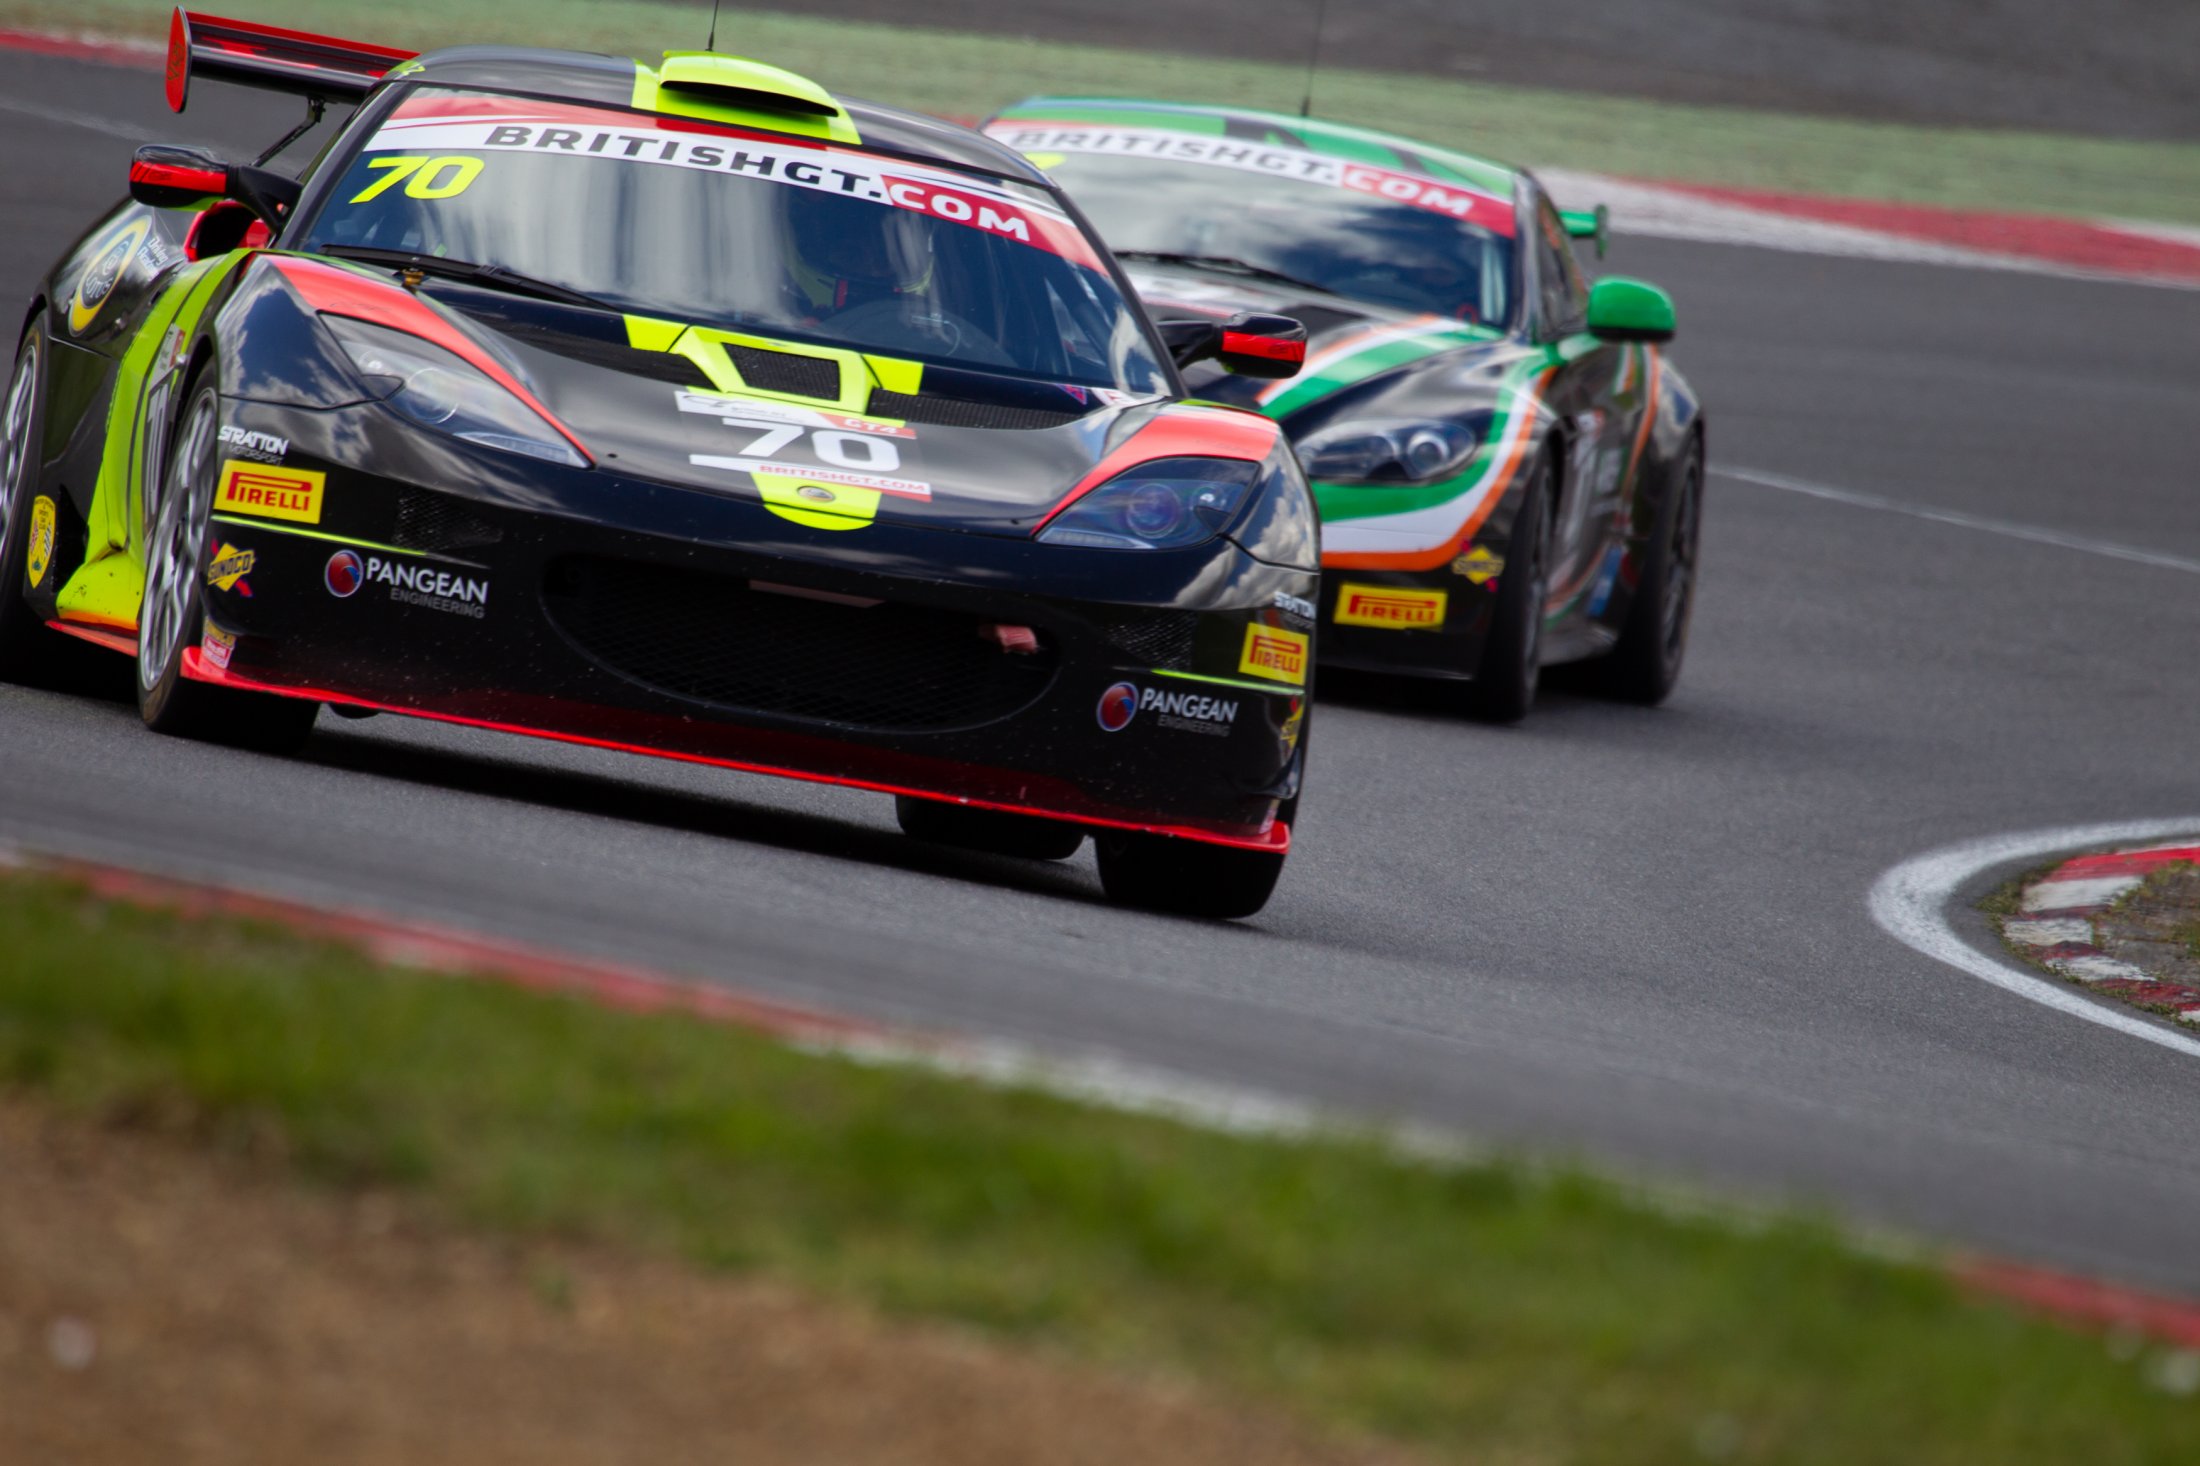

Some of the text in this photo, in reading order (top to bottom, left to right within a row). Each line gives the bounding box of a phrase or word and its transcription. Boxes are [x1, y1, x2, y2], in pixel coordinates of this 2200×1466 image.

[348, 156, 485, 204] 70
[484, 125, 1031, 241] BRITISHGT.COM
[1010, 130, 1474, 216] BRITISHGT.COM
[217, 425, 289, 455] STRATTON
[722, 417, 900, 473] 70
[844, 418, 898, 435] GT4
[226, 471, 313, 512] PIRELLI
[758, 464, 927, 491] BRITISHGT.COM
[366, 557, 489, 604] PANGEAN
[390, 588, 485, 619] ENGINEERING
[1349, 594, 1438, 622] PIRELLI
[1249, 634, 1303, 674] PIRELLI
[1139, 688, 1238, 722] PANGEAN
[1157, 715, 1232, 737] ENGINEERING
